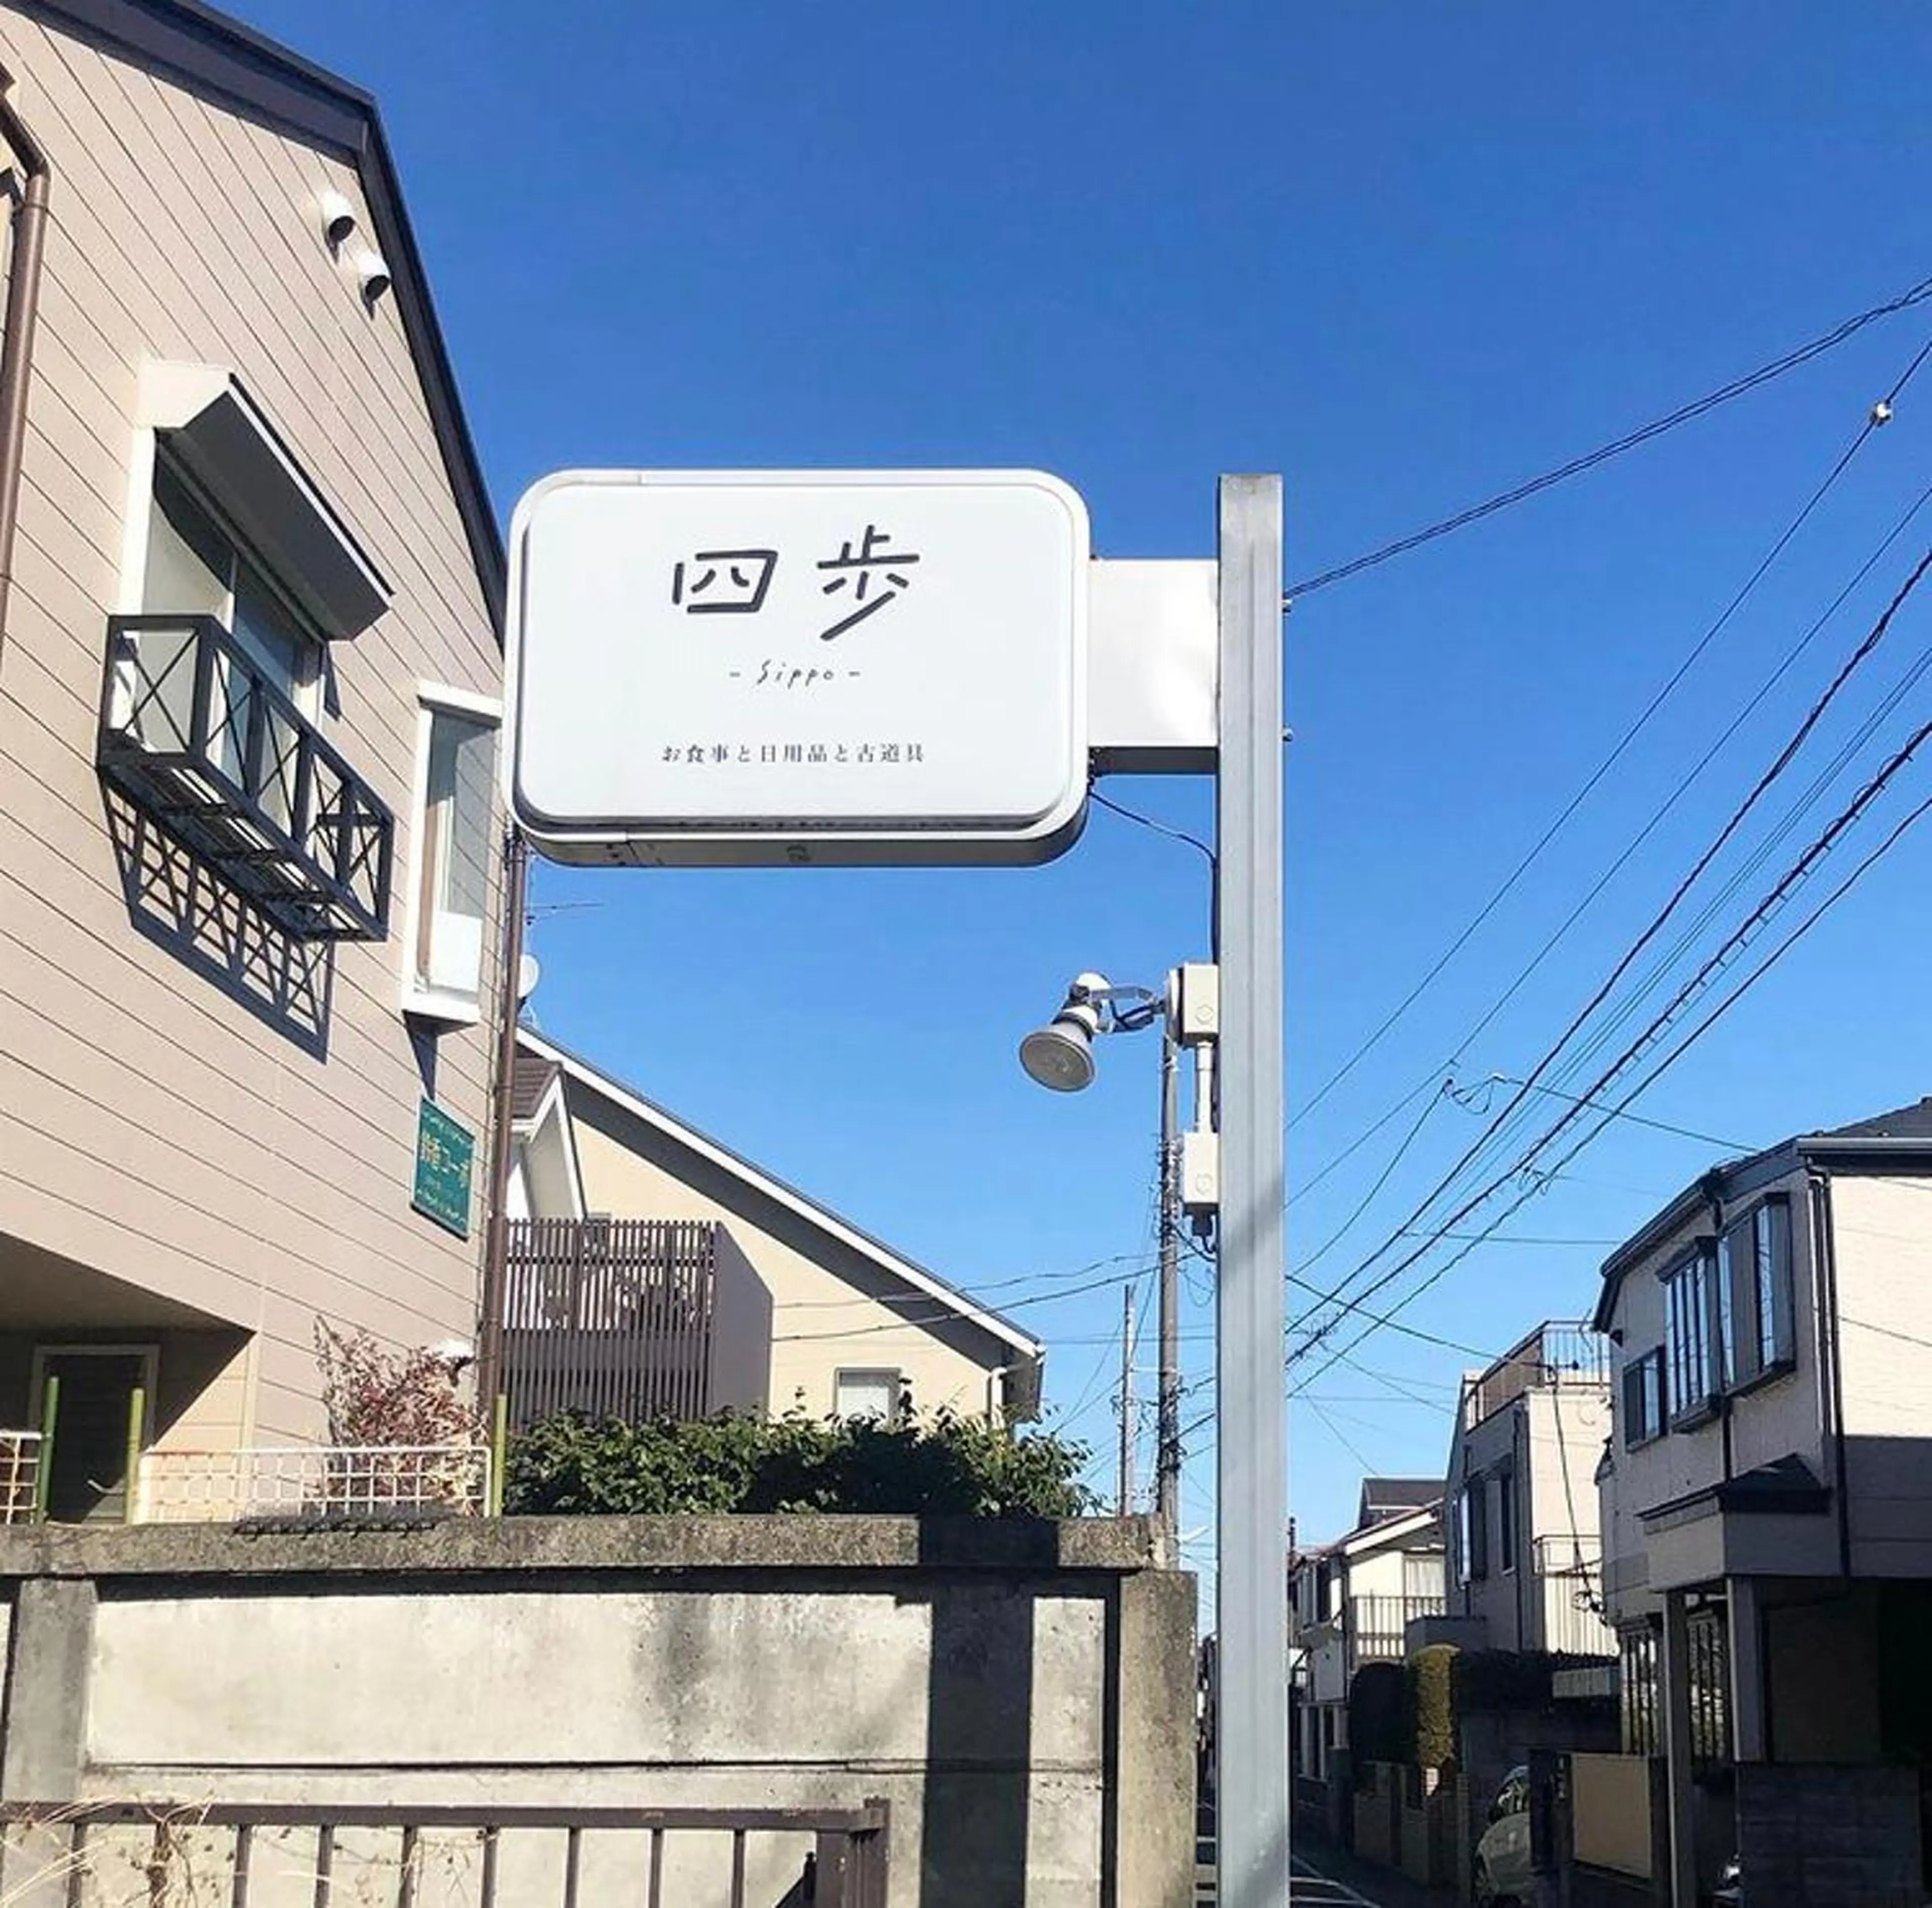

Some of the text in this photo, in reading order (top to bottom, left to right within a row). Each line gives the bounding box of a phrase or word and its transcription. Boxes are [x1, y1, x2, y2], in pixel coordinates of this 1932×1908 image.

[672, 525, 920, 641] 四歩
[662, 744, 923, 763] お食事と日用品と古道具
